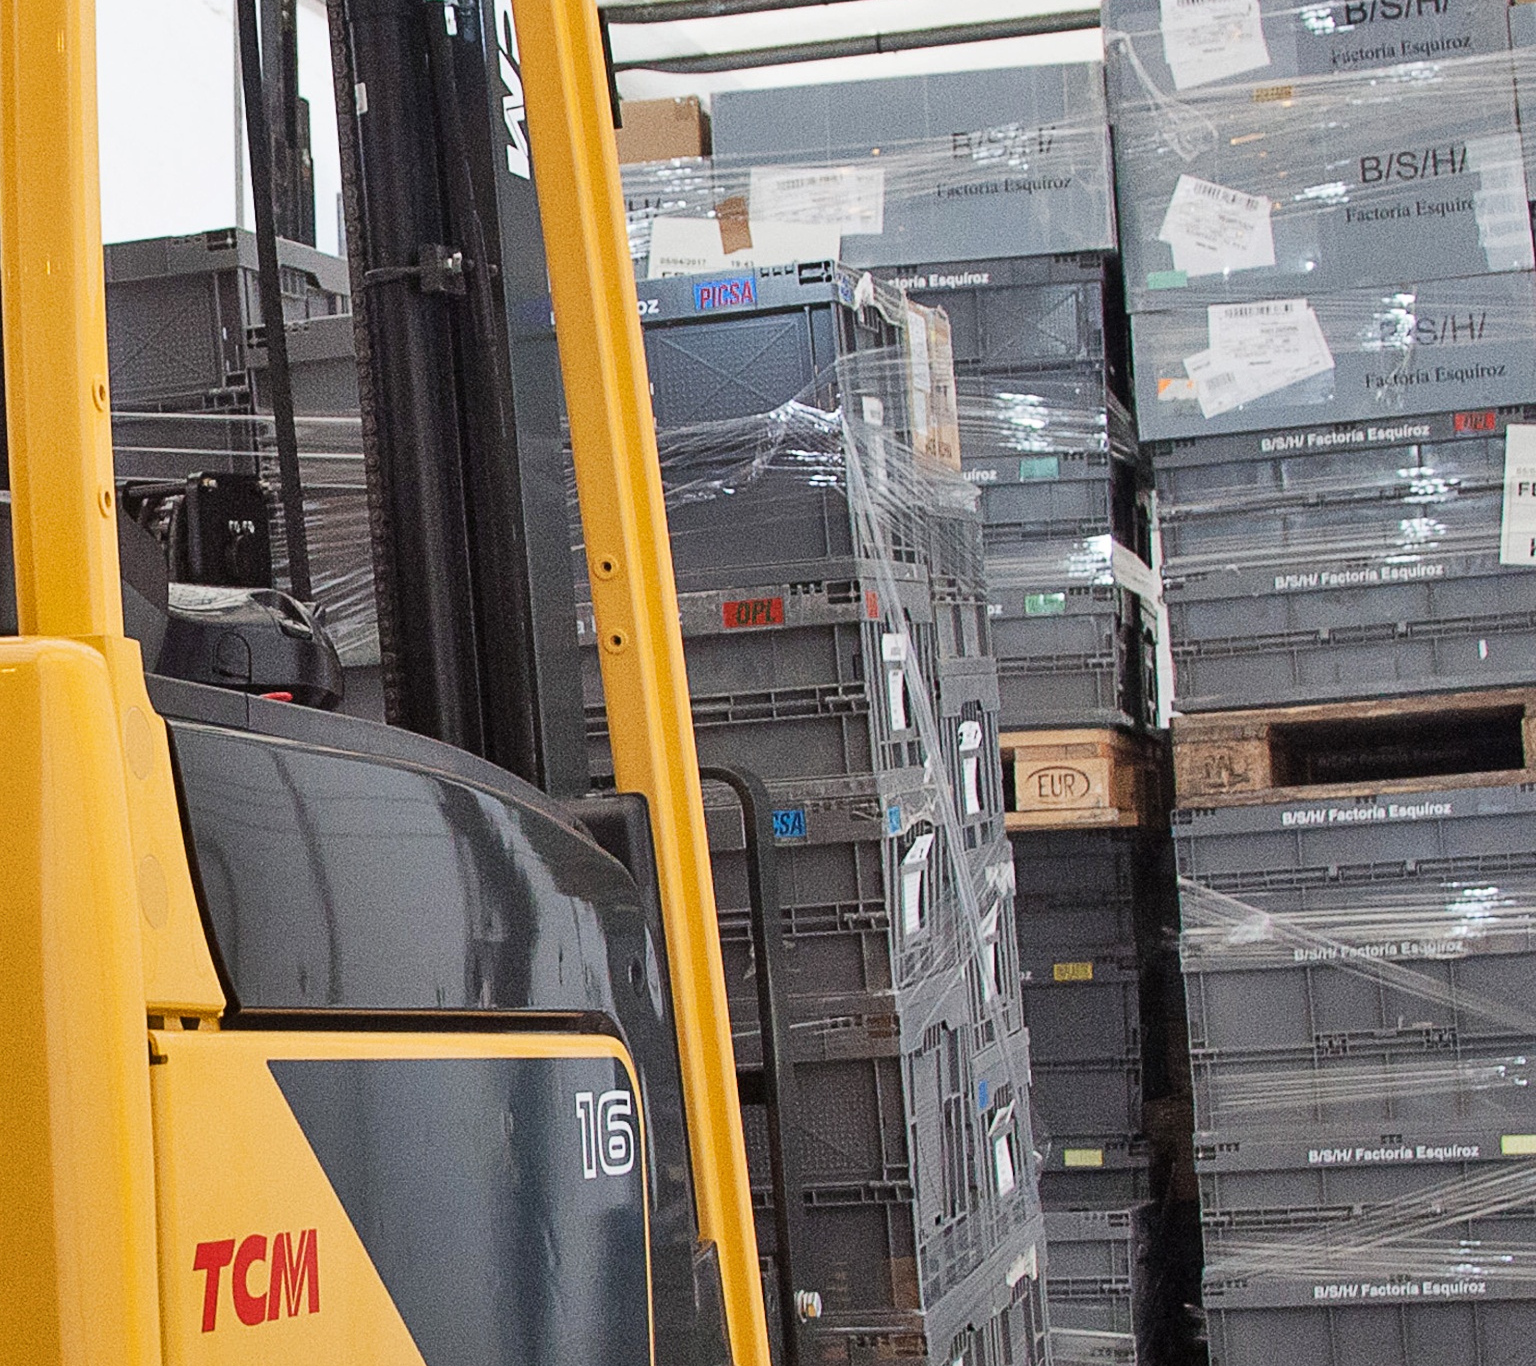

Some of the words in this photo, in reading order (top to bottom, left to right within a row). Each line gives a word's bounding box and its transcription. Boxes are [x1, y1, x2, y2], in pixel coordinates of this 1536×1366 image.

[1360, 146, 1467, 183] B/S/H/
[1416, 197, 1477, 217] Esquíro
[888, 274, 926, 289] ctoría
[700, 280, 754, 310] PICSA
[963, 469, 998, 482] uíroz
[736, 600, 775, 625] OPL
[1037, 773, 1075, 799] EUR
[575, 1090, 636, 1179] 16
[192, 1228, 321, 1334] TCM
